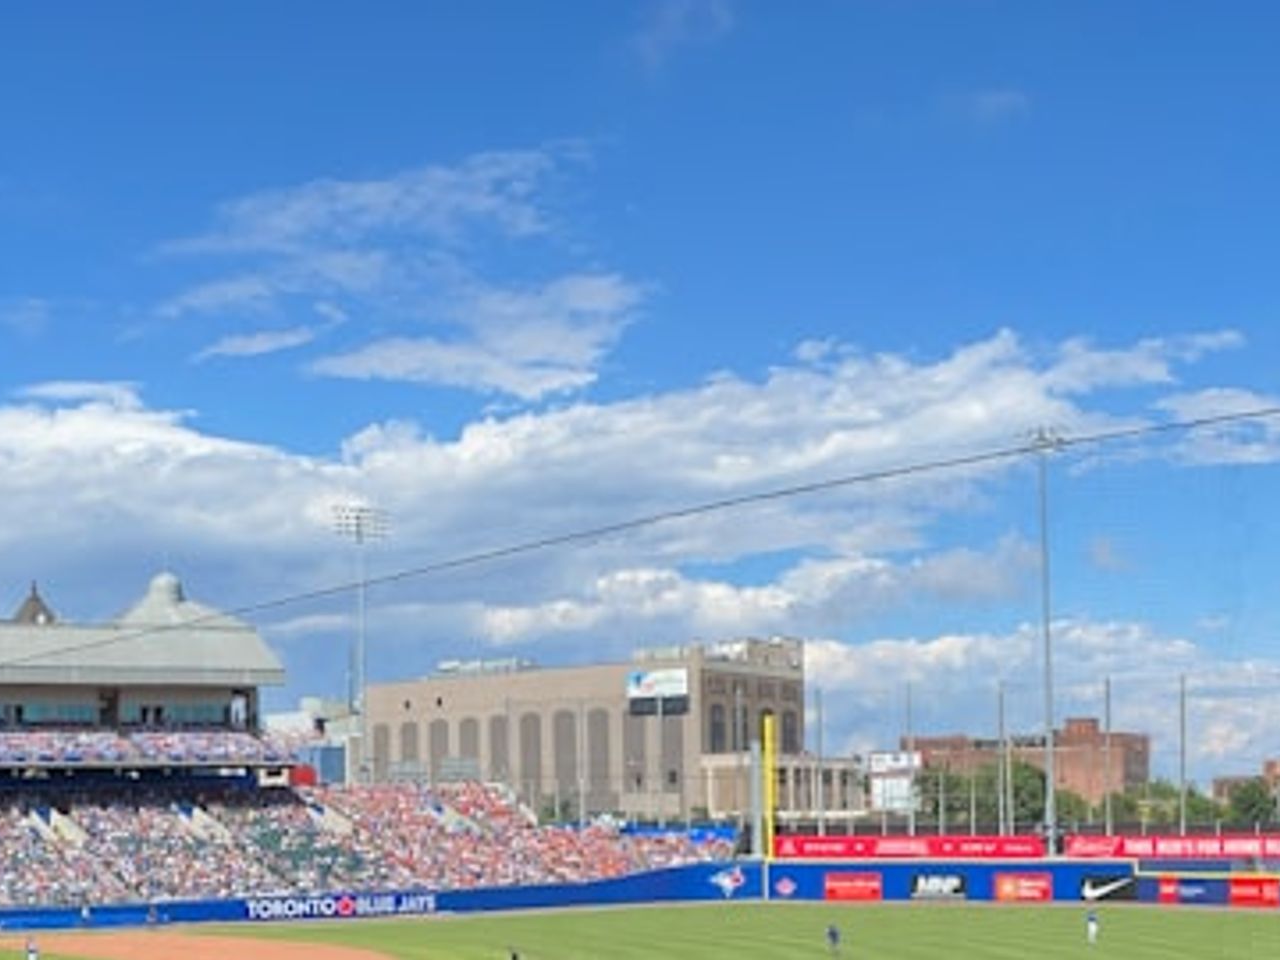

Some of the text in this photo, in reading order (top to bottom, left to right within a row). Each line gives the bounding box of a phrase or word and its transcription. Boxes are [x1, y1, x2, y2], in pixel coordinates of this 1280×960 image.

[246, 894, 436, 919] TORONTO BLUE JAYS
